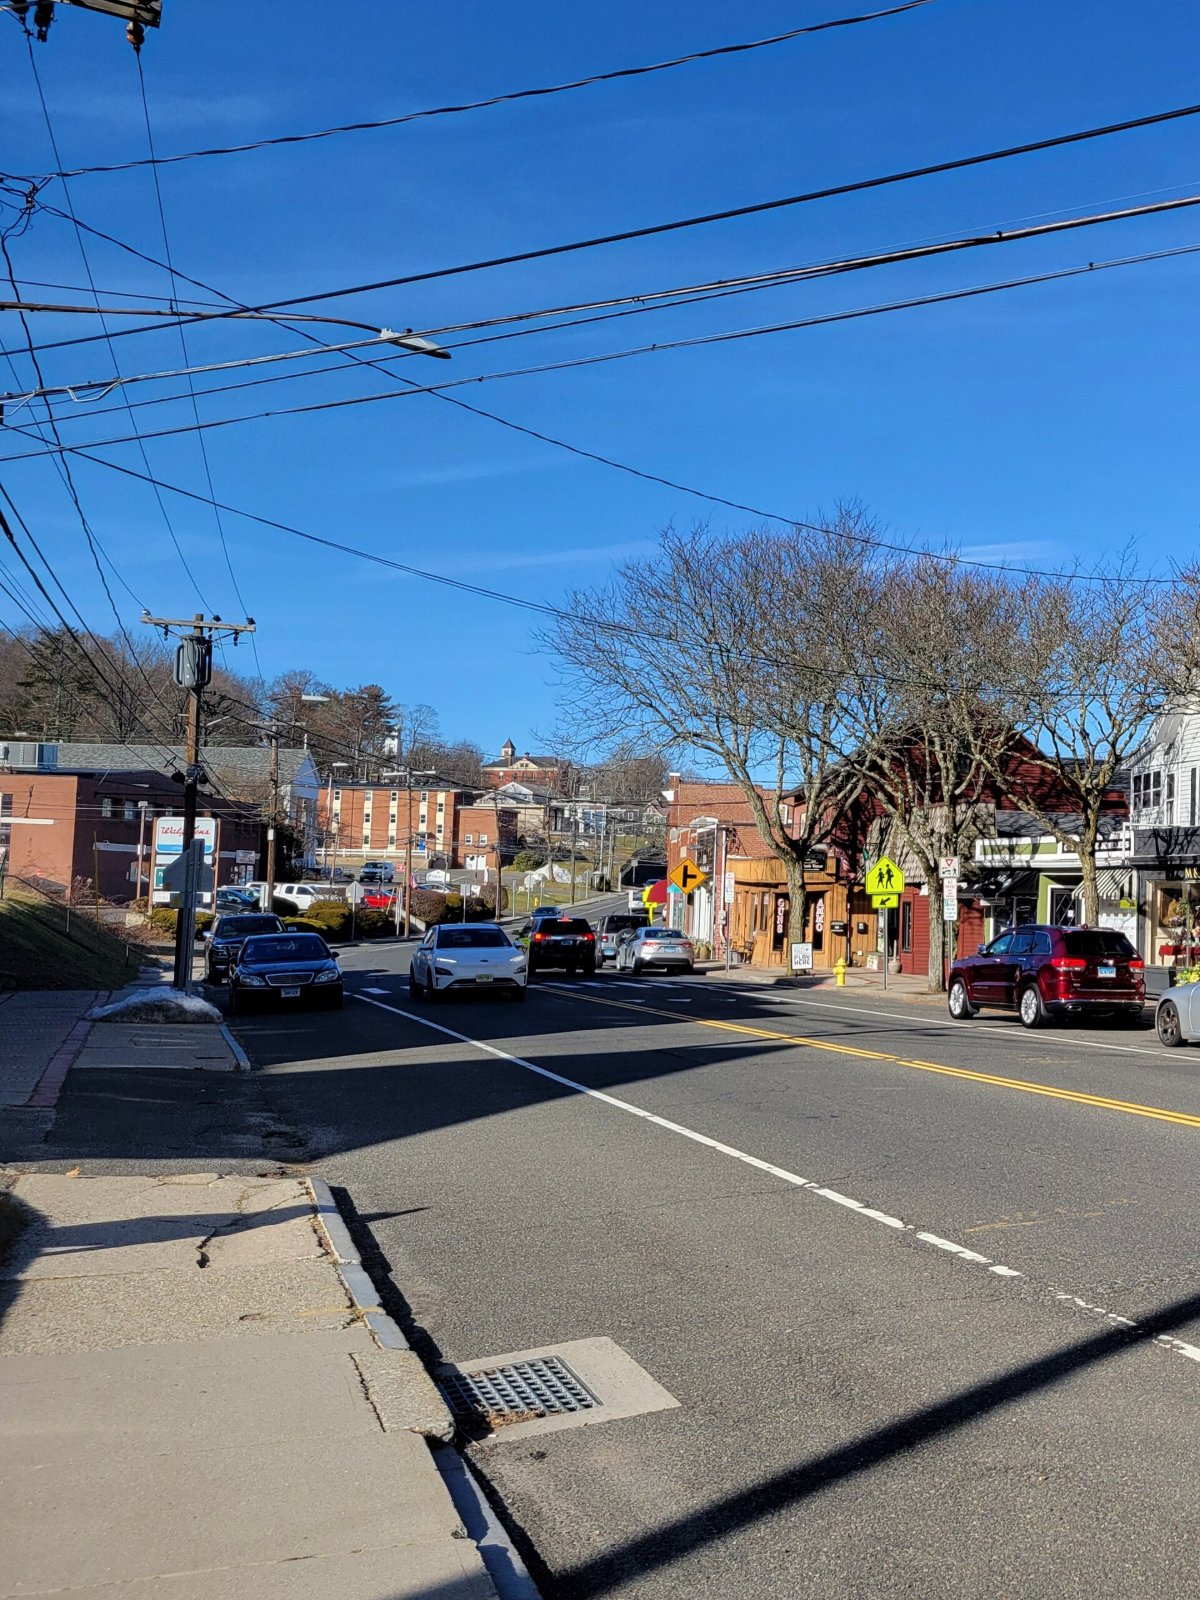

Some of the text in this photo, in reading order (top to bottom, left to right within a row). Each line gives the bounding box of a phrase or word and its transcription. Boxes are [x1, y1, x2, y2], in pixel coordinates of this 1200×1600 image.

[160, 826, 211, 836] Walgens
[776, 898, 785, 933] GUNS
[815, 898, 824, 932] AMMO
